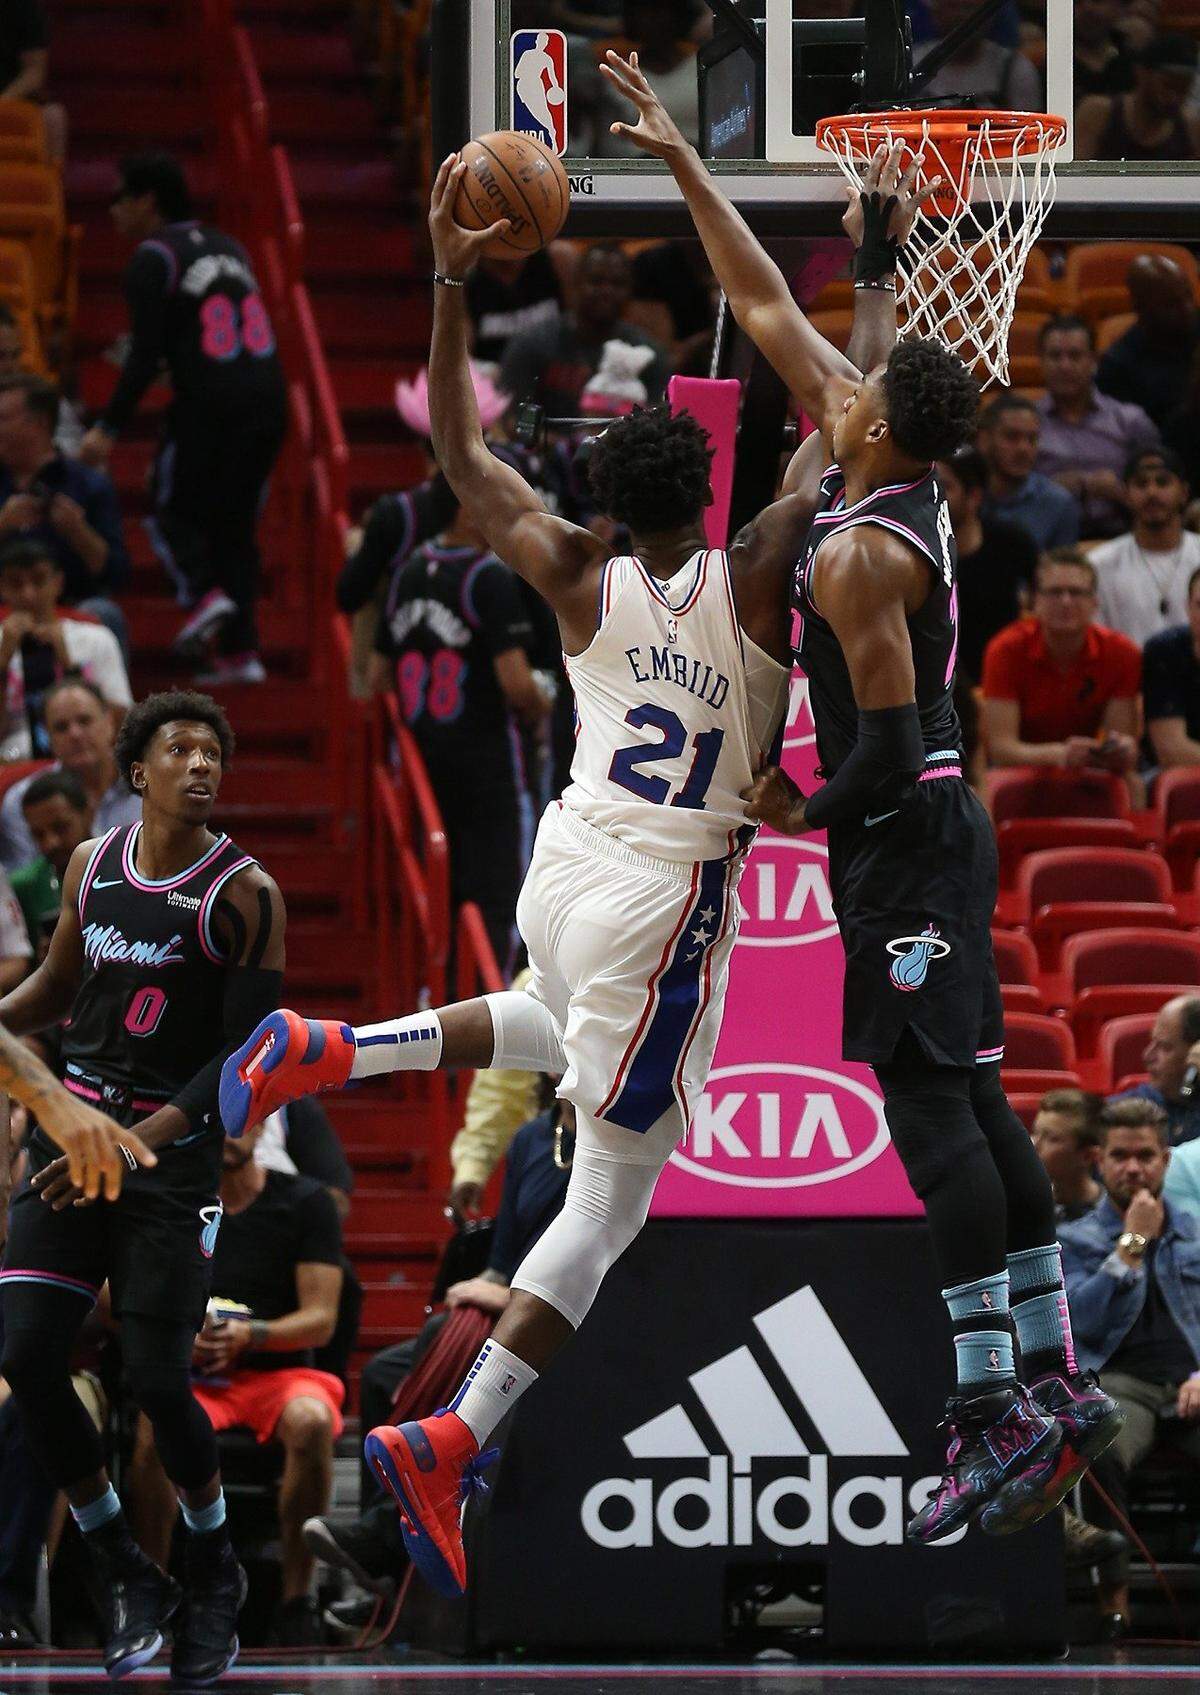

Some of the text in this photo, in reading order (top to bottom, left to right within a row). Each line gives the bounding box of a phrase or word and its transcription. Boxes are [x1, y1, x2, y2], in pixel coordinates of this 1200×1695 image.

[200, 293, 275, 361] 88
[625, 645, 730, 710] EMBIID
[608, 702, 724, 810] 21
[737, 863, 837, 921] IA
[82, 922, 185, 970] Miami
[124, 986, 168, 1037] 0
[692, 1092, 853, 1159] KIA
